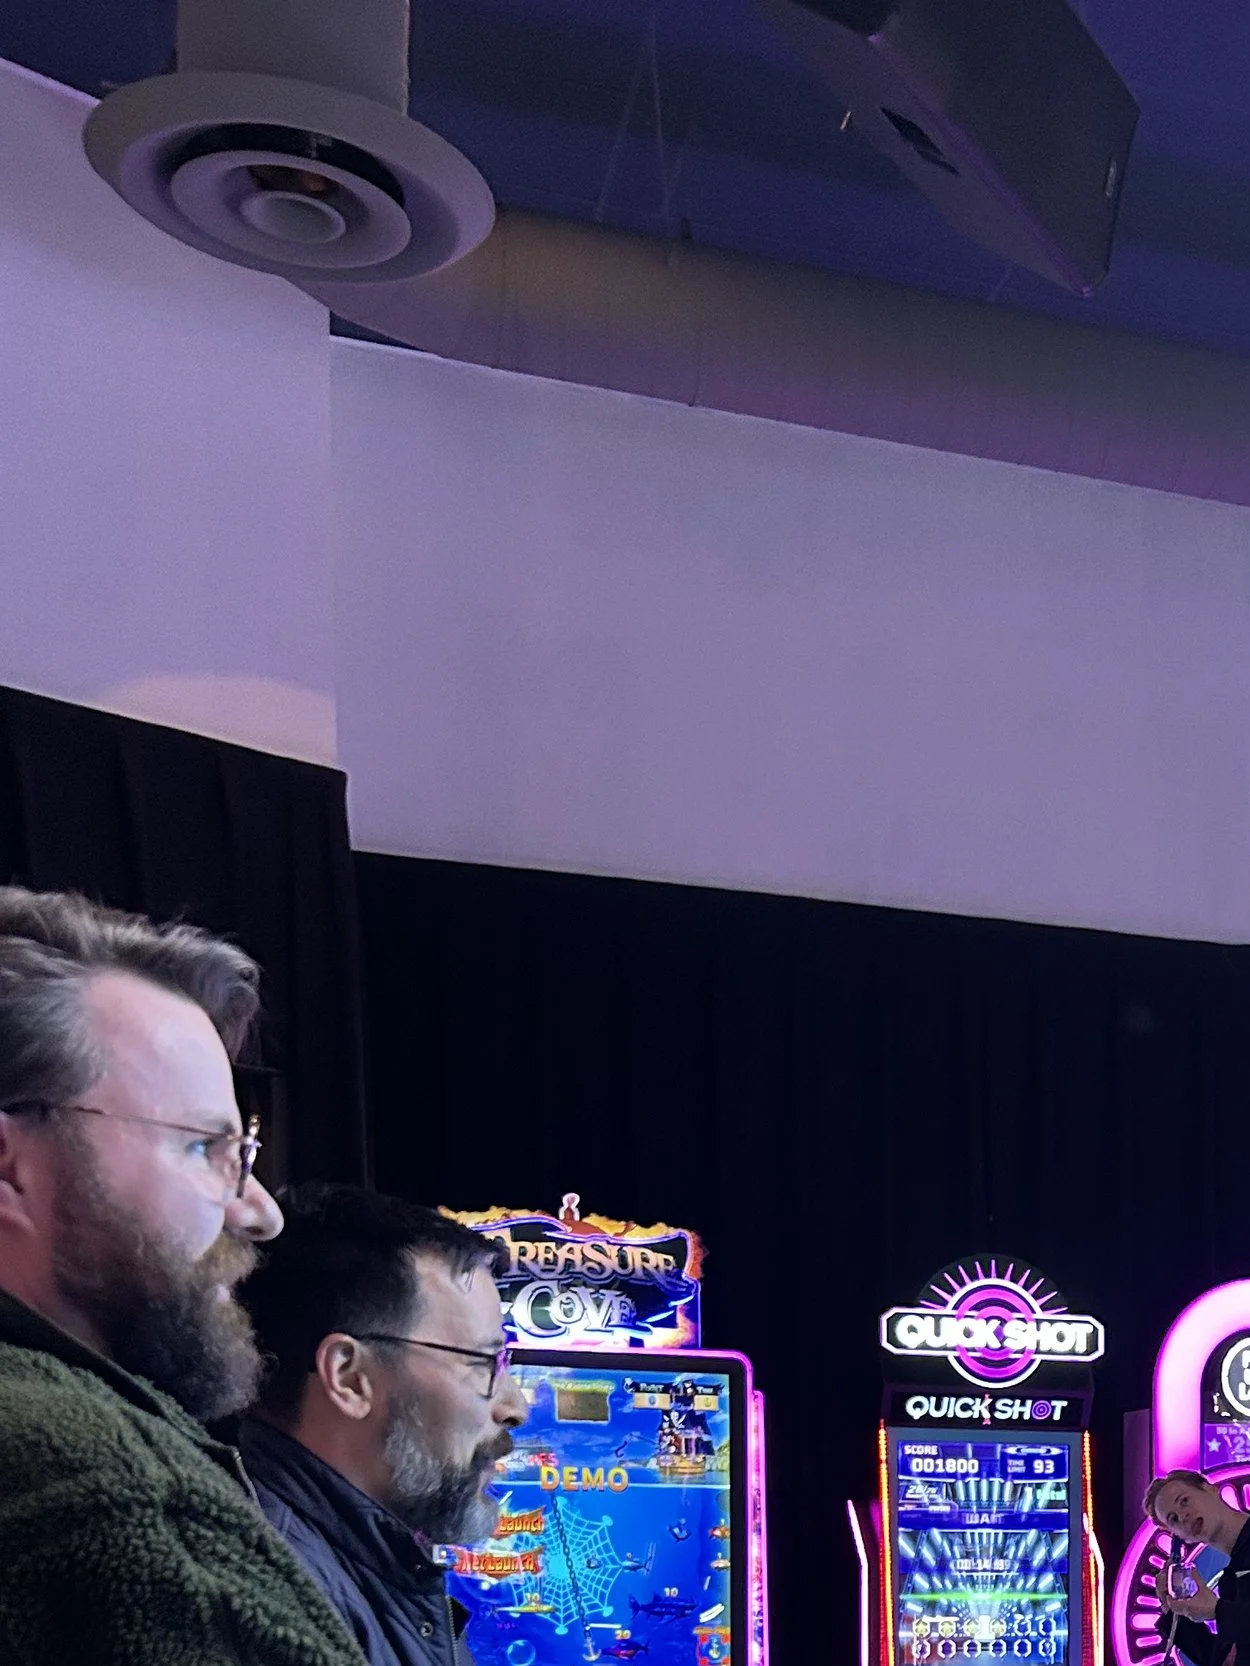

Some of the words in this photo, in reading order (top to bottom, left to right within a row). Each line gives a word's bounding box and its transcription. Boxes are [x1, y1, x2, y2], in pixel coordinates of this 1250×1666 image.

[895, 1314, 1001, 1349] QUICK
[1003, 1319, 1093, 1353] SHOT
[905, 1395, 993, 1420] QUICK
[994, 1398, 1068, 1421] SHOT
[904, 1445, 939, 1456] SCORE
[539, 1465, 630, 1494] DEMO
[911, 1458, 979, 1474] 001800
[1033, 1459, 1055, 1475] 93
